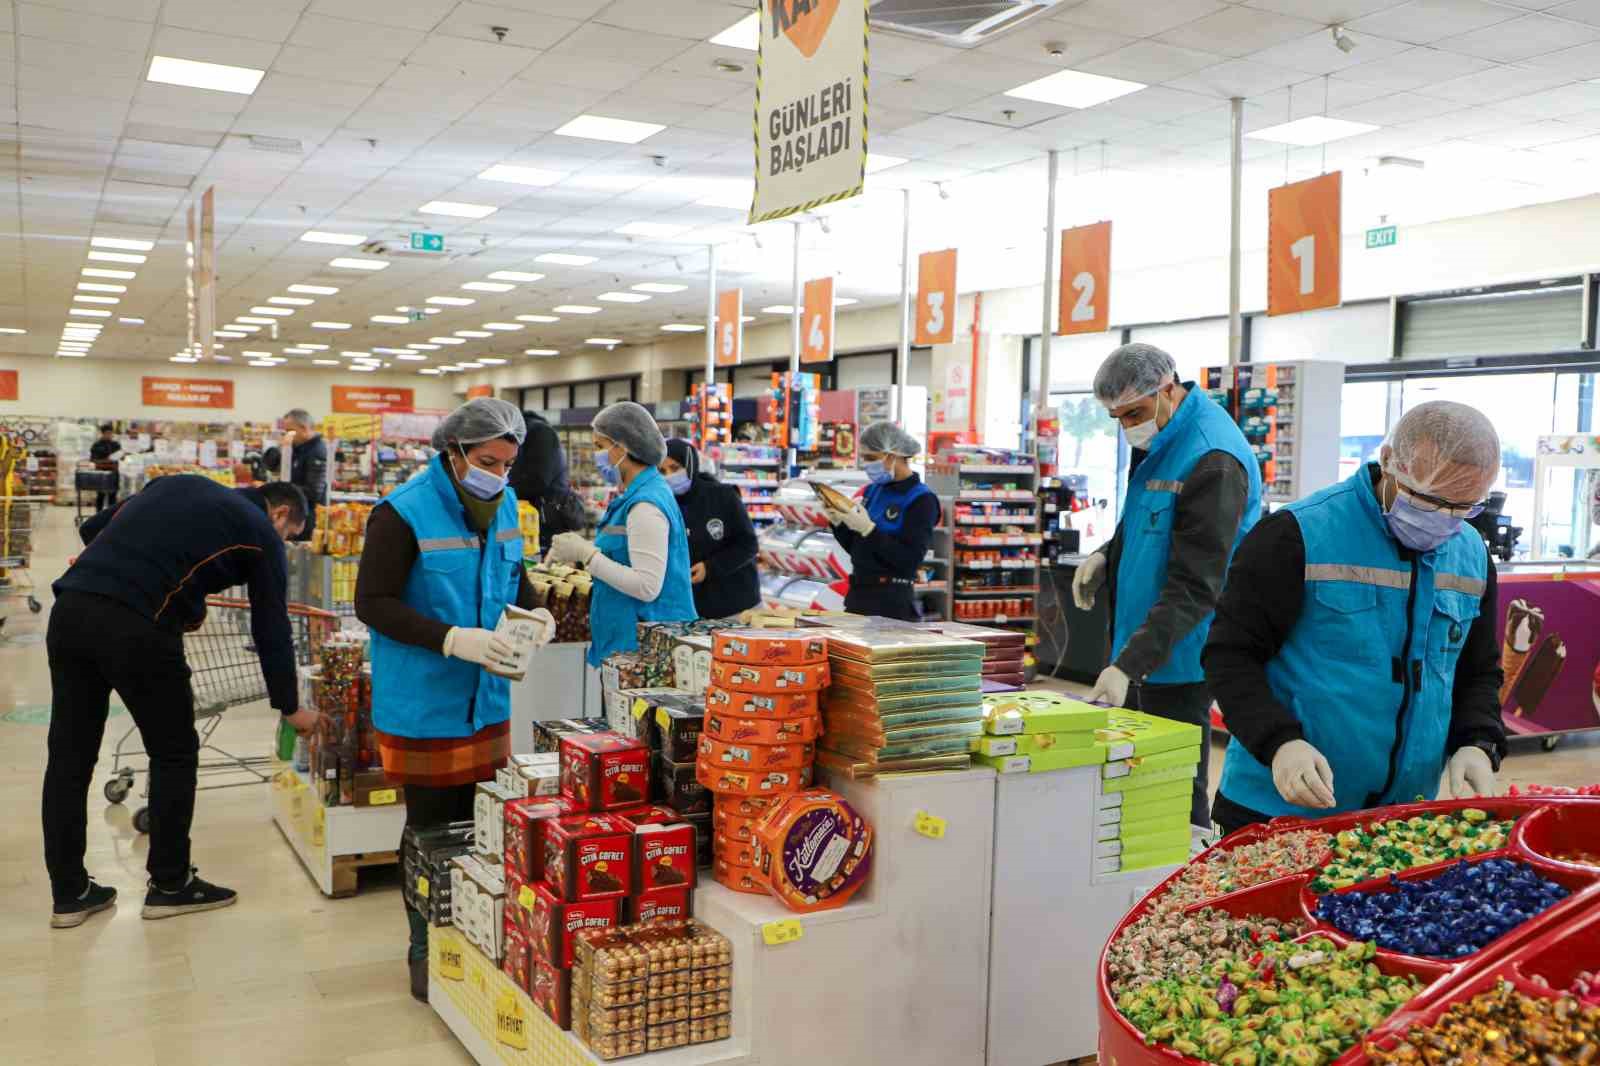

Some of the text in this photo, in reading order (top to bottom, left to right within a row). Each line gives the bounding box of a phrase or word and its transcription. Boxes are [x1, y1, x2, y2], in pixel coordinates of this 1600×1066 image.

[769, 77, 851, 141] GÜNLERİ
[770, 116, 851, 177] BAŞLADI
[1368, 228, 1395, 247] EXIT
[1290, 234, 1315, 296] 1
[926, 291, 945, 335] 3
[1071, 271, 1095, 322] 2
[808, 313, 825, 353] 4
